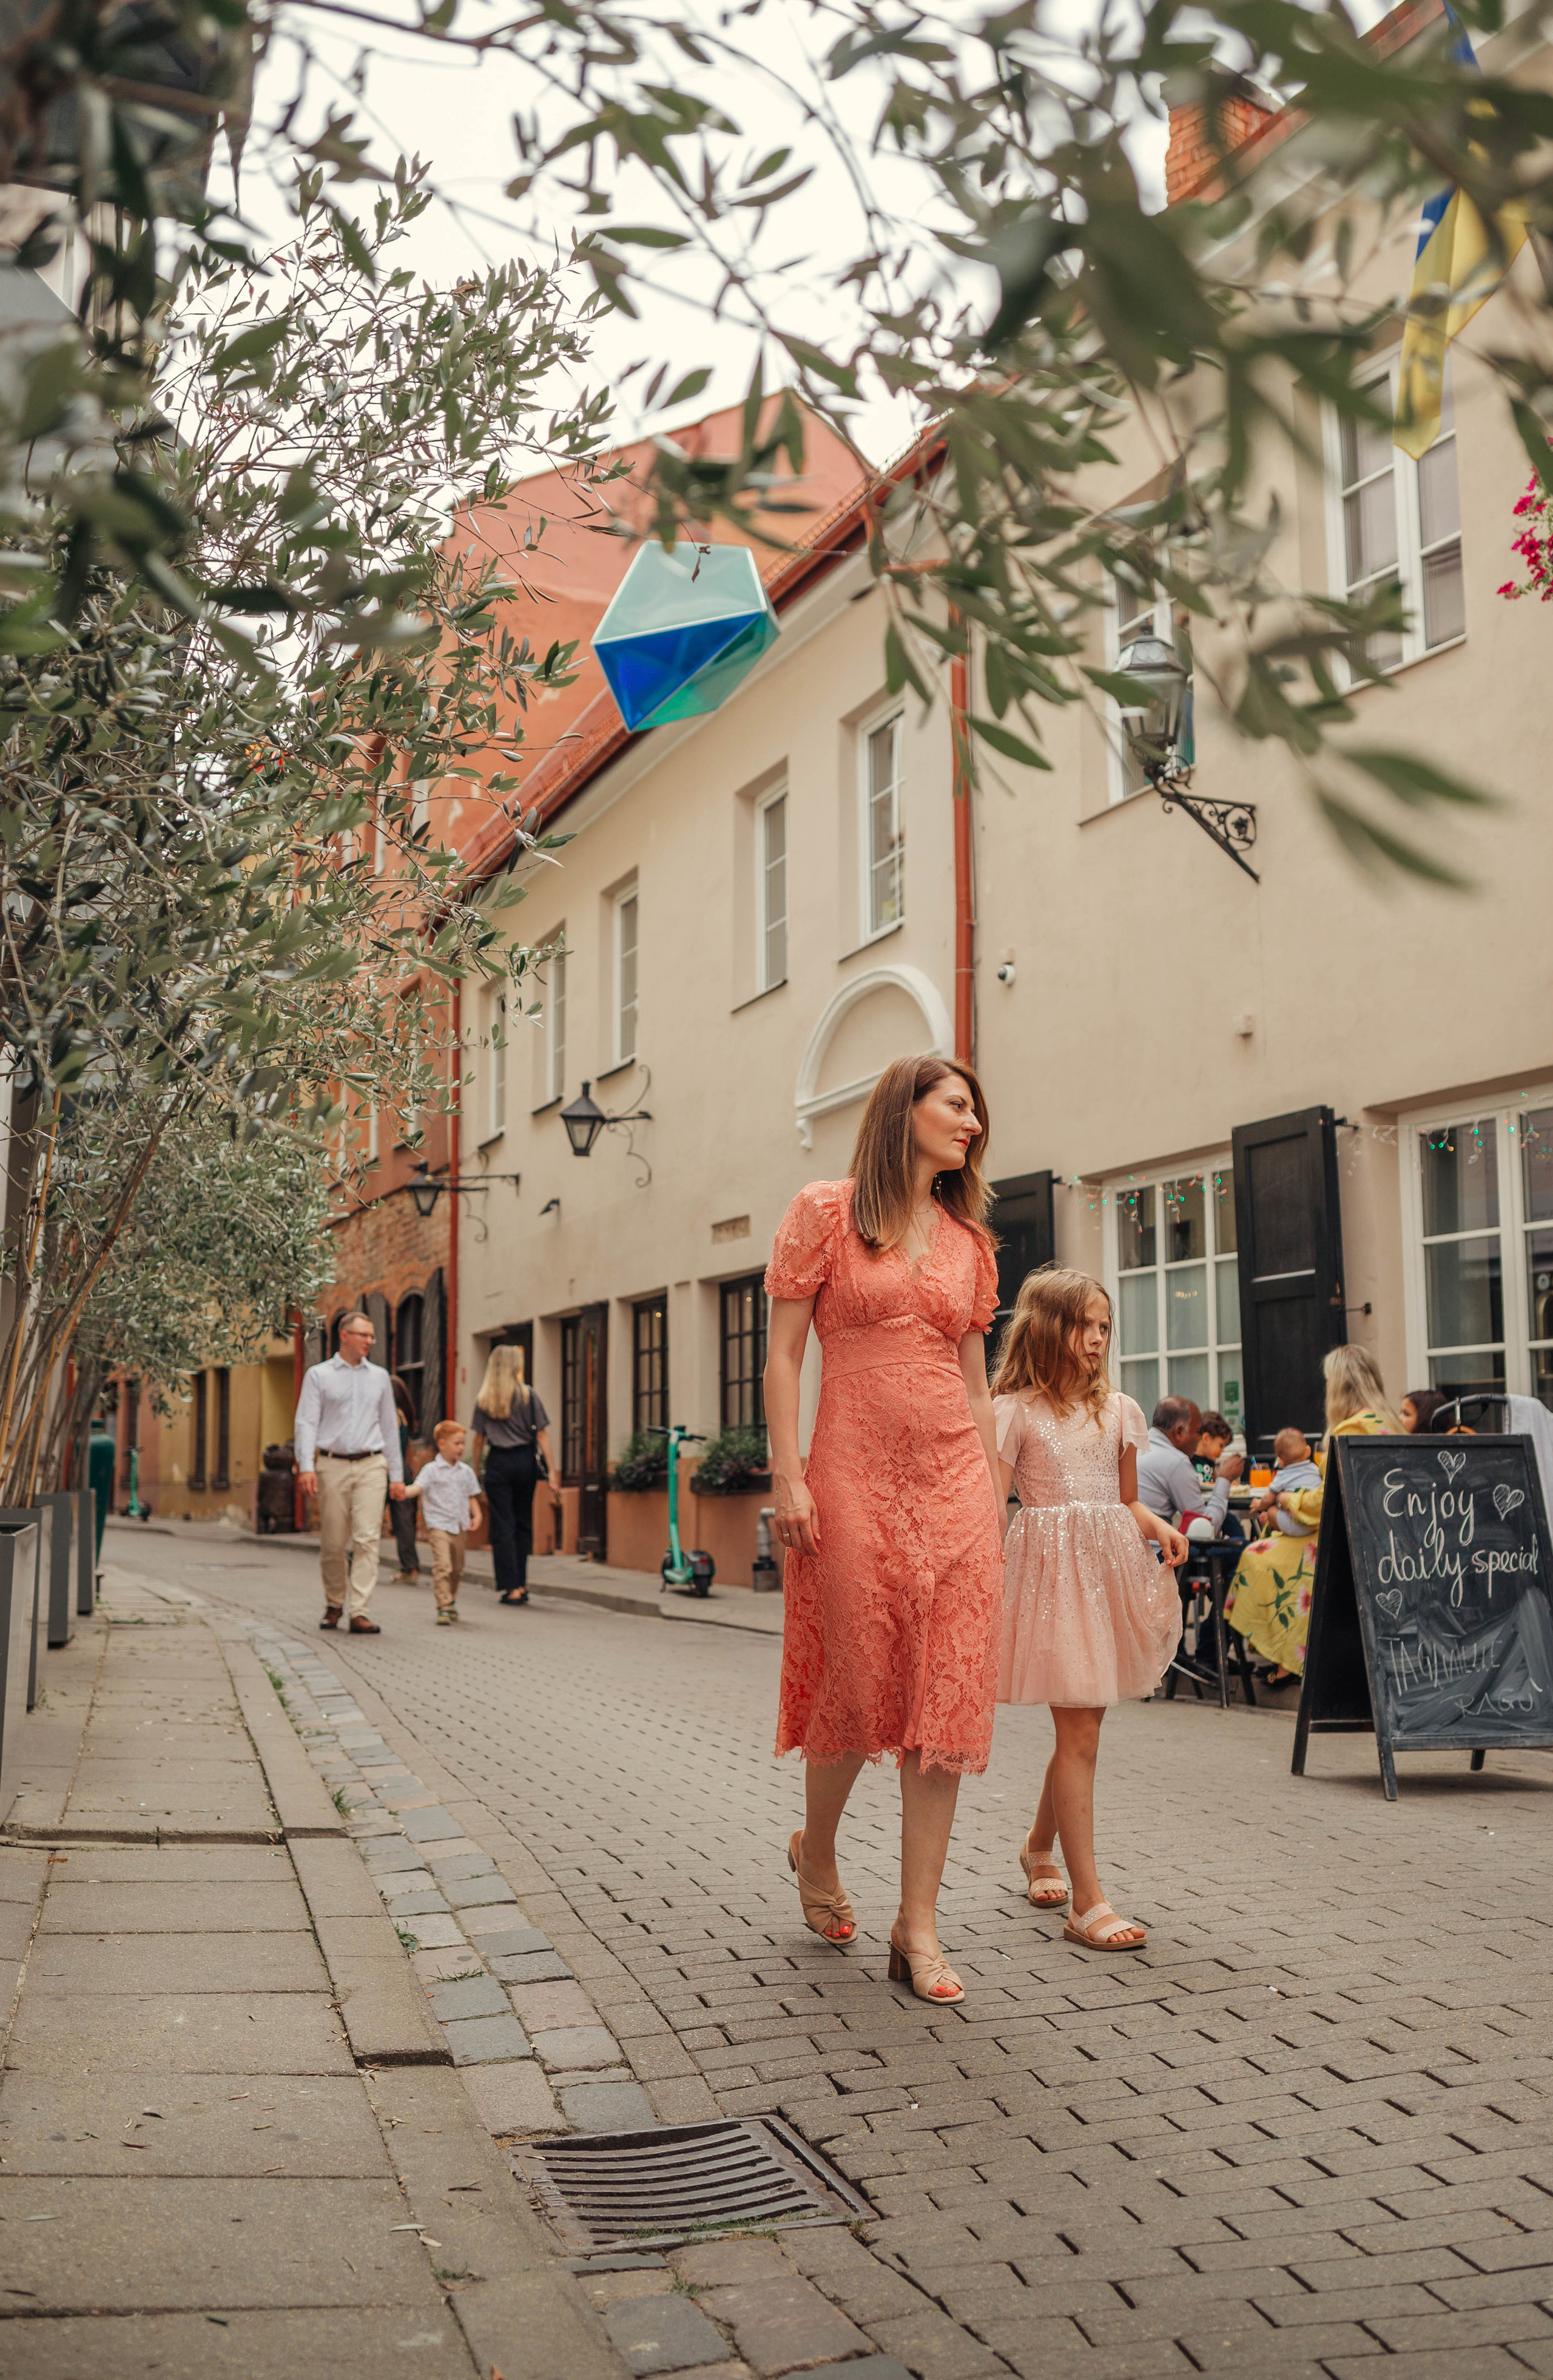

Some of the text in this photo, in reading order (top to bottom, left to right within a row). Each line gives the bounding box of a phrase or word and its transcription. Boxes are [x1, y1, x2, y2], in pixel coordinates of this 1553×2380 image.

[1383, 1467, 1475, 1548] Enjoy
[1378, 1527, 1538, 1608] daily special
